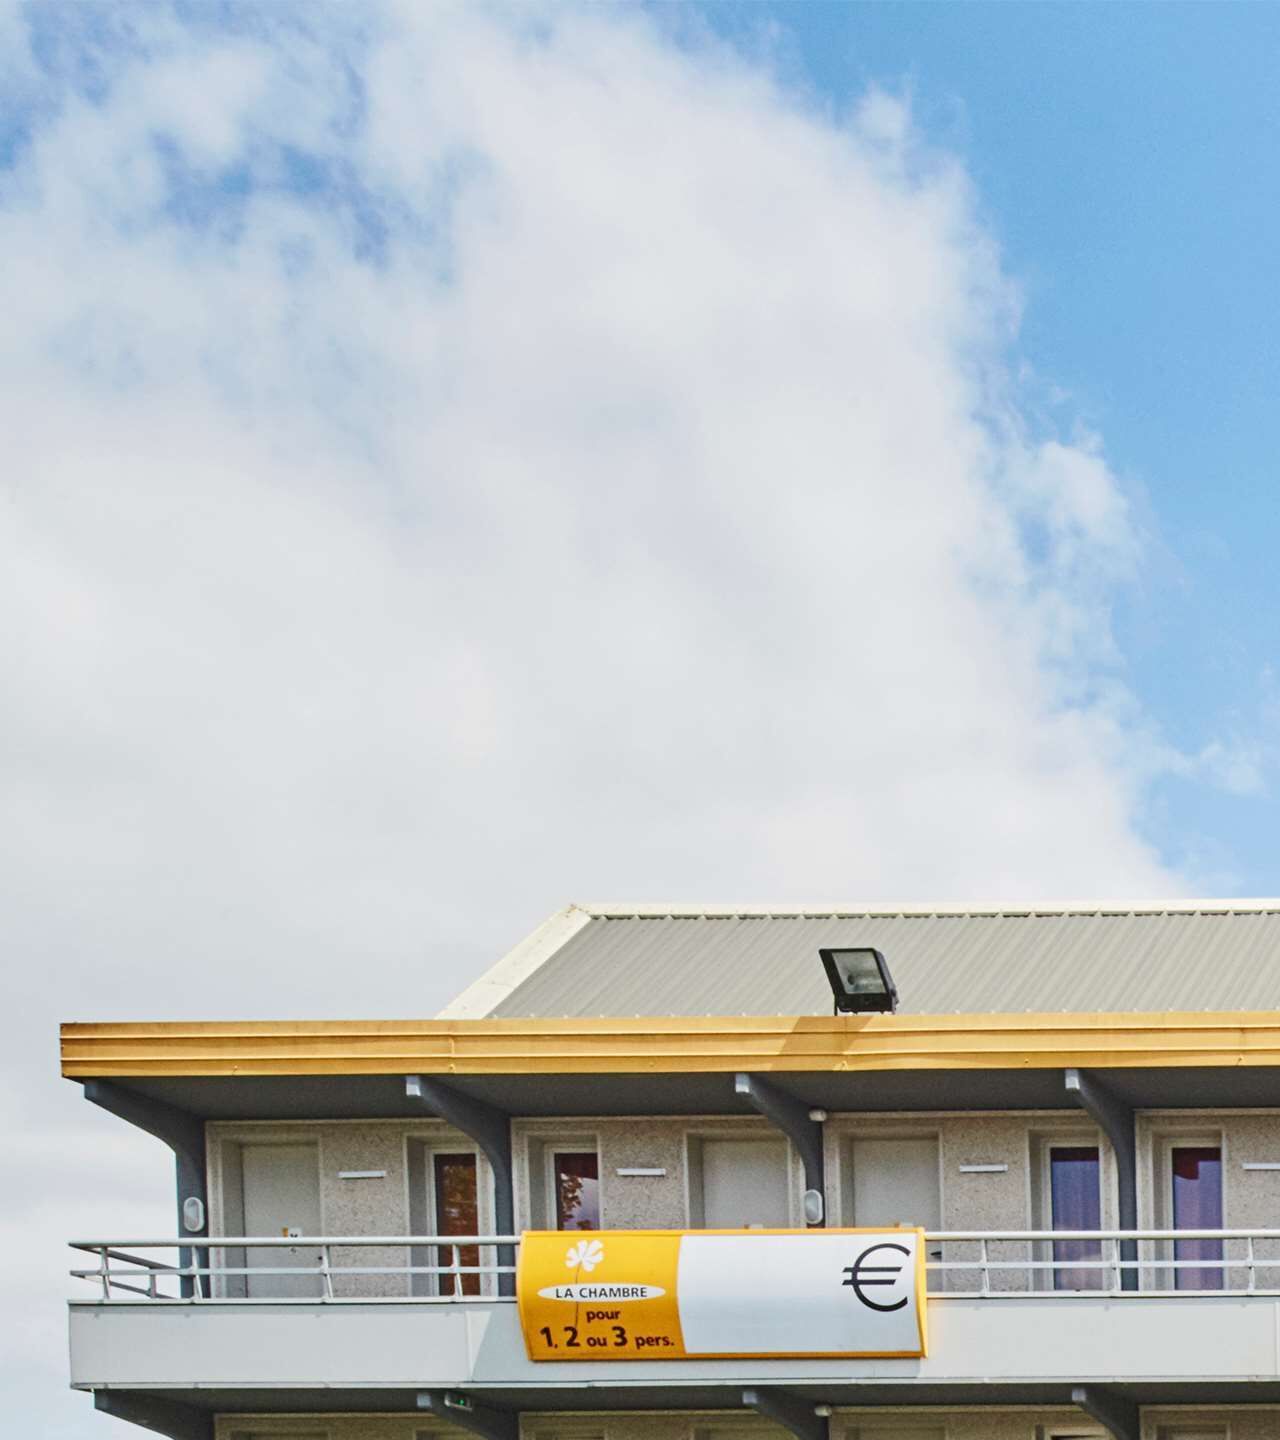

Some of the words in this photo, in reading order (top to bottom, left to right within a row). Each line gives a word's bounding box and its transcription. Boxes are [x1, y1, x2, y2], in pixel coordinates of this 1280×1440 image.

[555, 1287, 573, 1298] LA
[579, 1287, 648, 1298] CHAMBRE
[586, 1309, 620, 1322] pour
[566, 1326, 580, 1347] 2
[587, 1335, 607, 1347] ou
[613, 1326, 628, 1348] 3
[635, 1335, 674, 1350] pers.
